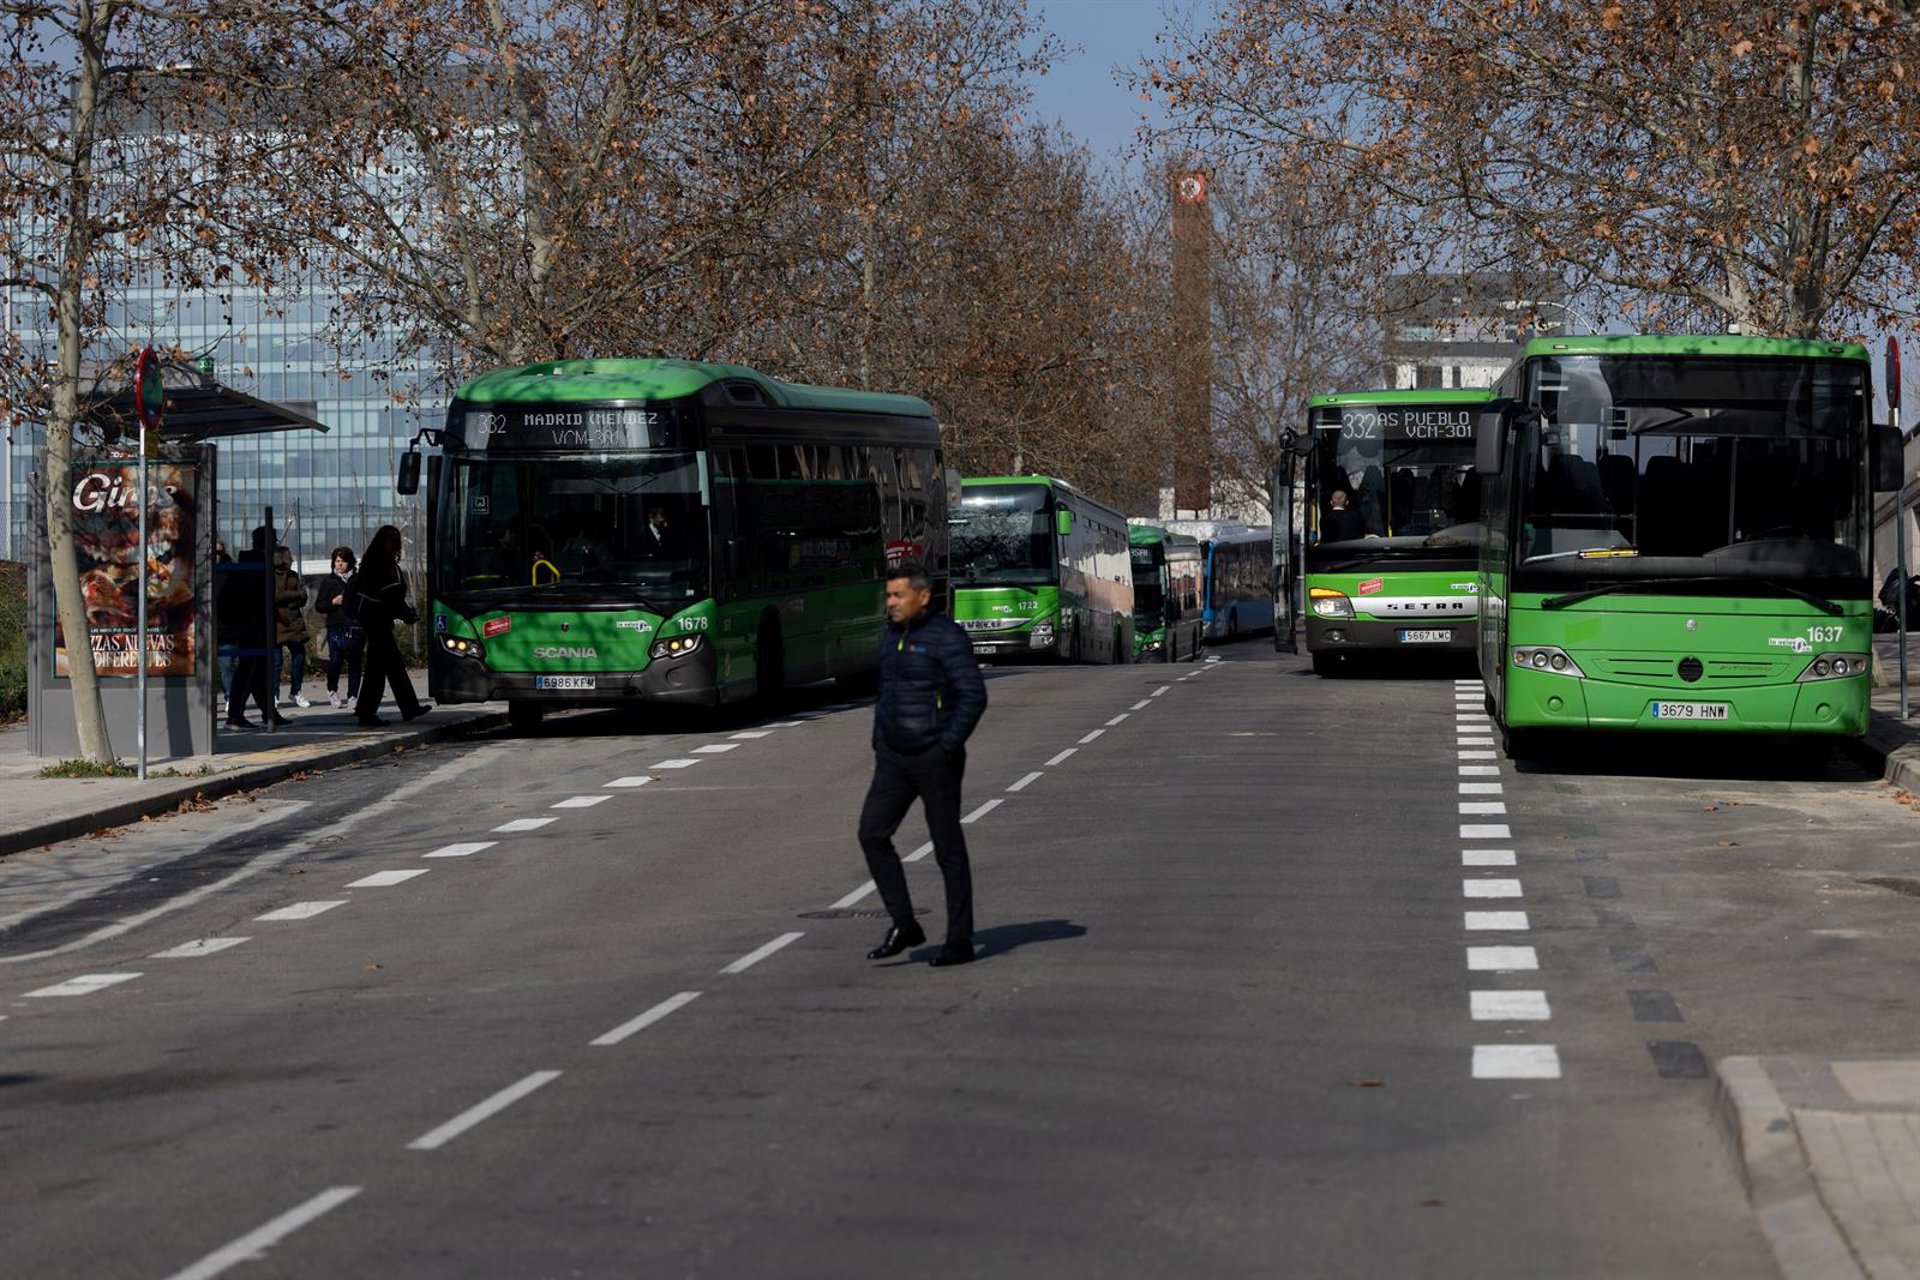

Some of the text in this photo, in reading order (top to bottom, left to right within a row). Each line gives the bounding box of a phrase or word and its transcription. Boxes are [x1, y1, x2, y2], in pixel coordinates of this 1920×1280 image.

[478, 414, 507, 434] 332
[524, 413, 583, 426] MADRID
[1377, 411, 1470, 427] AS PUEBLO
[1343, 413, 1377, 439] 332
[1405, 425, 1472, 438] VCM-301
[1018, 601, 1039, 611] 1722
[1386, 602, 1464, 611] SETRA
[677, 617, 708, 631] 1678
[1407, 631, 1430, 641] 5667
[1806, 626, 1844, 643] 1637
[533, 647, 598, 659] SCANIA
[543, 677, 572, 689] 6986
[1660, 704, 1694, 717] 3679
